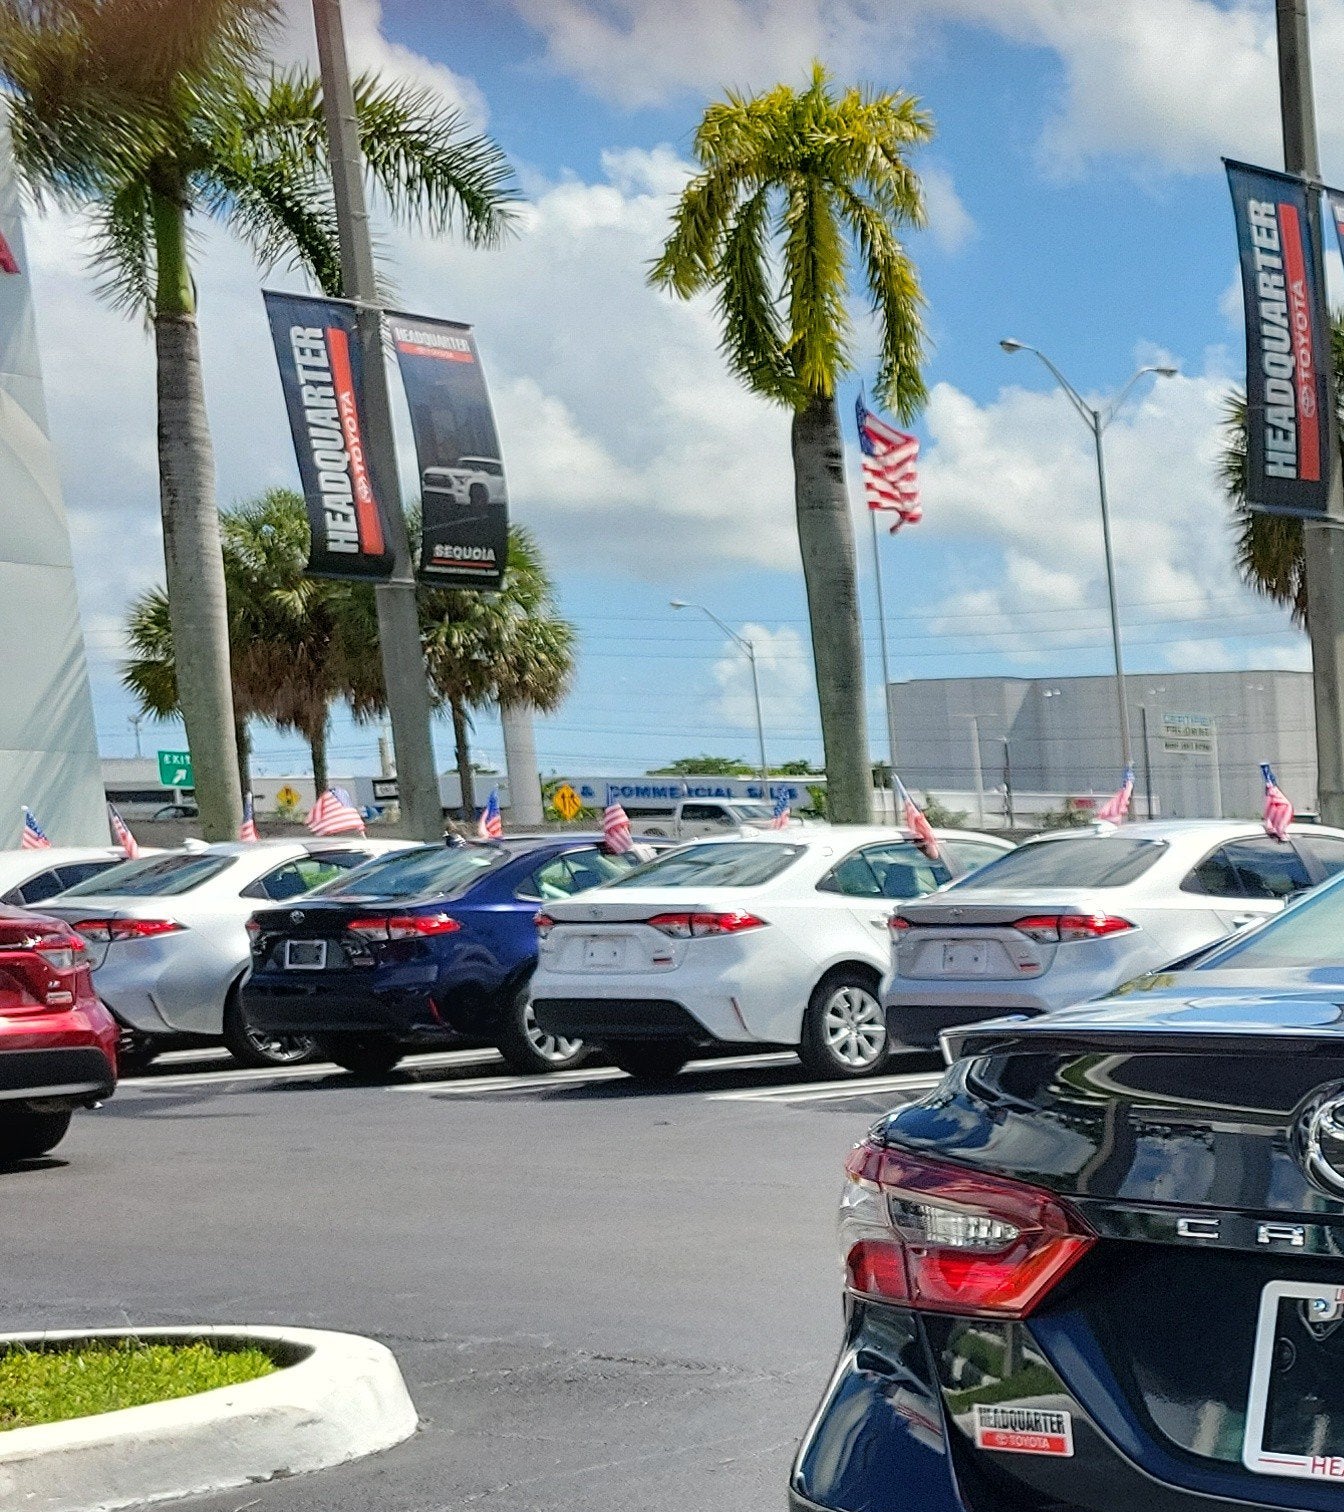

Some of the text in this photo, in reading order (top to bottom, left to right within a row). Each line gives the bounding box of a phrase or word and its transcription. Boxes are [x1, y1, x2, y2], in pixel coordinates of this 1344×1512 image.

[1250, 201, 1298, 480] HEADQUARTER
[1290, 280, 1313, 380] TOYOTA
[290, 325, 359, 553] HEADQUARTER
[341, 391, 364, 472] TOYOTA
[434, 544, 496, 561] SEQUOIA
[979, 1406, 1066, 1434] HEADQUARTER
[1009, 1436, 1051, 1450] TOYOTA
